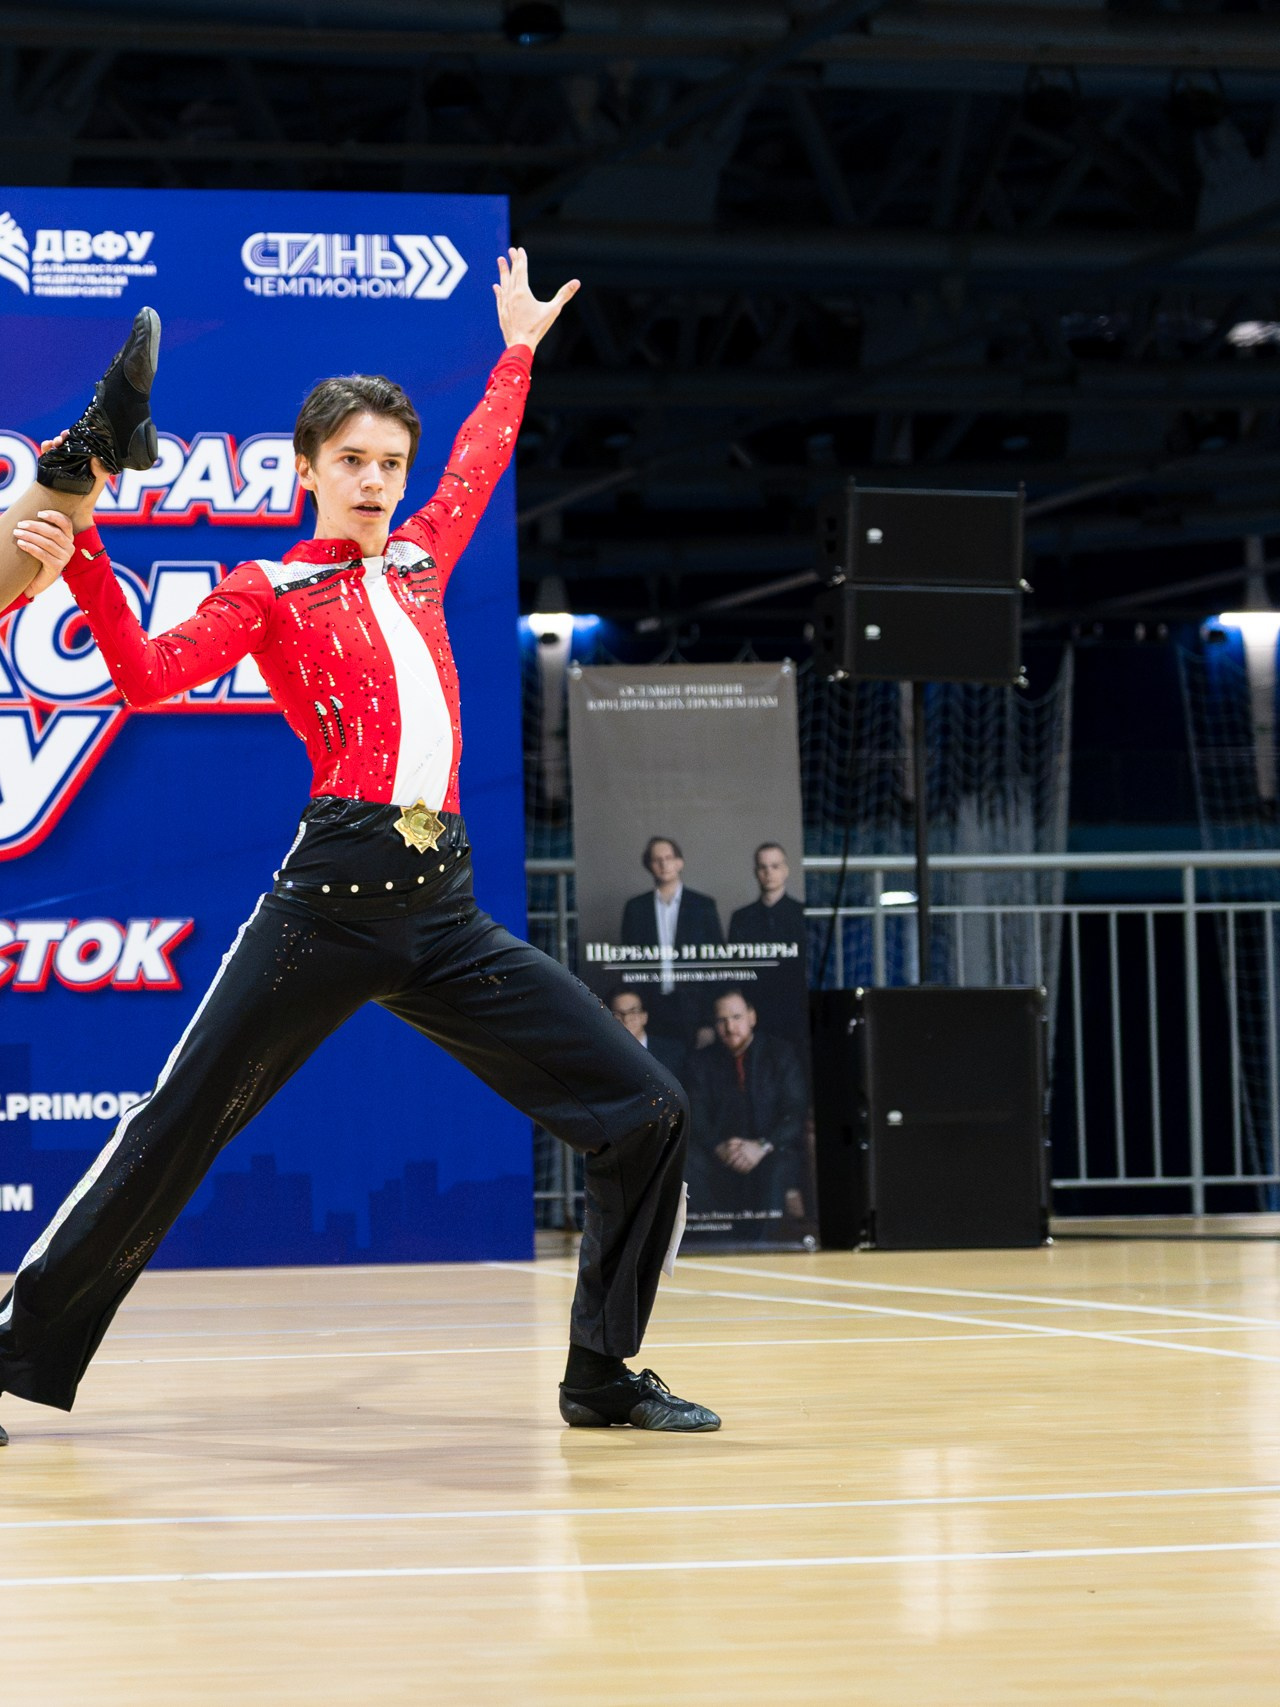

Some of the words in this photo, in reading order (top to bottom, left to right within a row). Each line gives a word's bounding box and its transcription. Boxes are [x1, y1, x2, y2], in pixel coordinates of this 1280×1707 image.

[32, 229, 155, 262] ДВФУ
[241, 232, 406, 277] СТАНЬ
[243, 276, 408, 298] ЧЕМПИОНОМ
[94, 431, 299, 515] РАЯ
